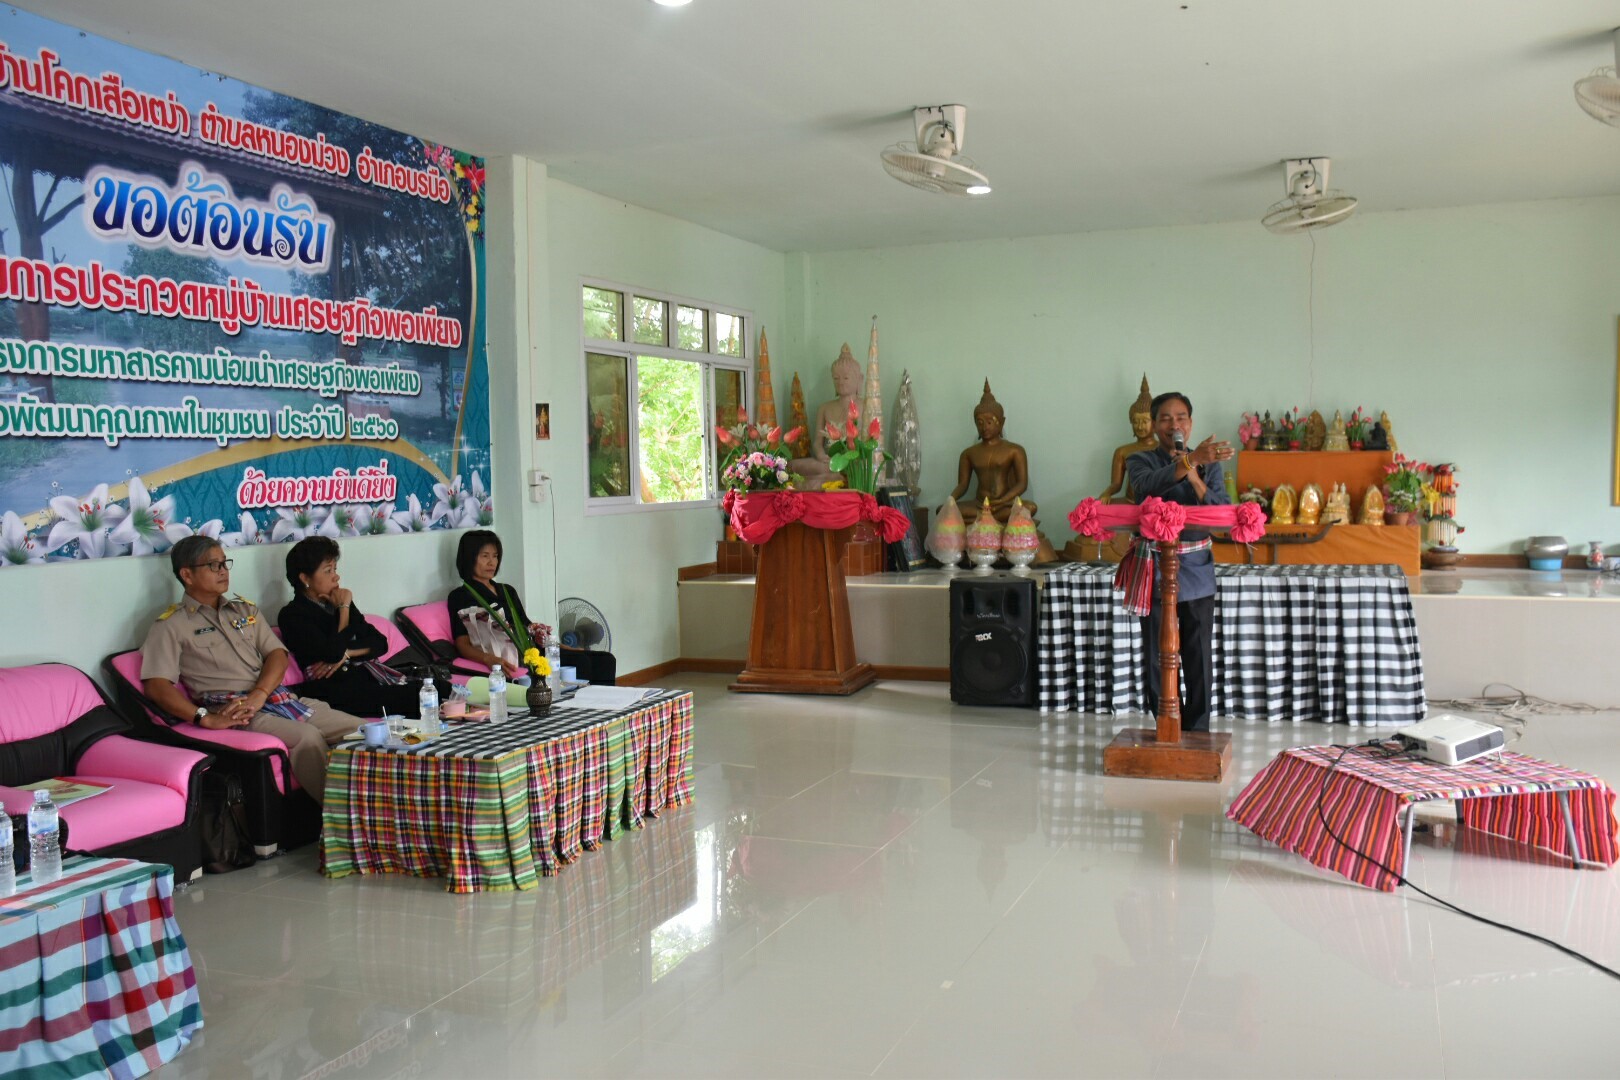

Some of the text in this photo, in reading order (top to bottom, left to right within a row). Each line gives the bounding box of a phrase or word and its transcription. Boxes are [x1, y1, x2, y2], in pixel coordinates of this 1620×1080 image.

[0, 45, 451, 202] ้านโคกเสือเฒ่า ตำบลหนองม่วง อำเภอบรบือ
[93, 171, 327, 264] ขอต้อนรับ
[278, 406, 343, 436] ประจำปี
[349, 416, 397, 437] ๒๕๖๐
[240, 463, 395, 505] ด้วยความยินดียิ่ง
